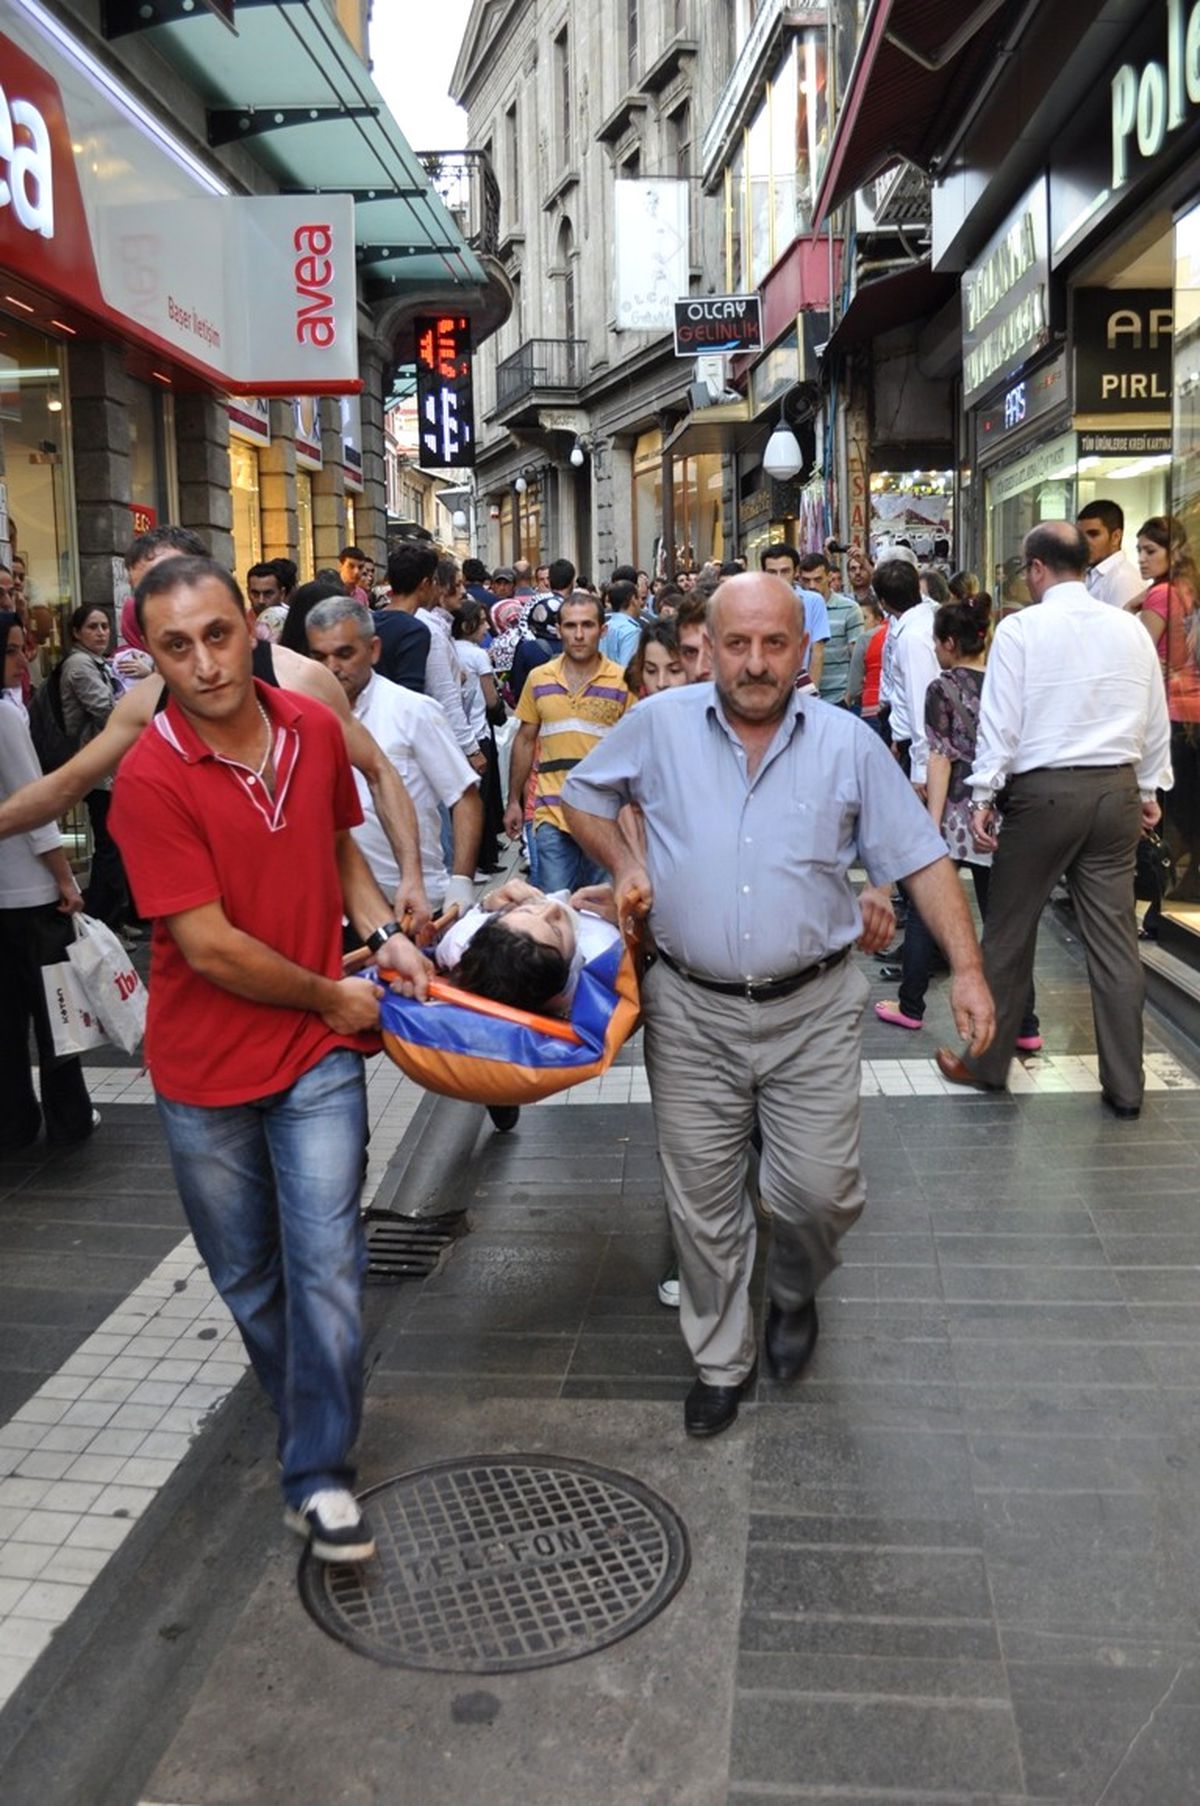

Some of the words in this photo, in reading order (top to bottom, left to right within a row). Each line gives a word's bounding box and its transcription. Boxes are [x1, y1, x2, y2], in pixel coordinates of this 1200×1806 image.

[293, 223, 336, 348] avea
[687, 302, 746, 321] OLCAY
[678, 319, 759, 343] GELİNLİK
[1101, 373, 1173, 399] PIRL
[402, 1528, 585, 1585] TELEFON
